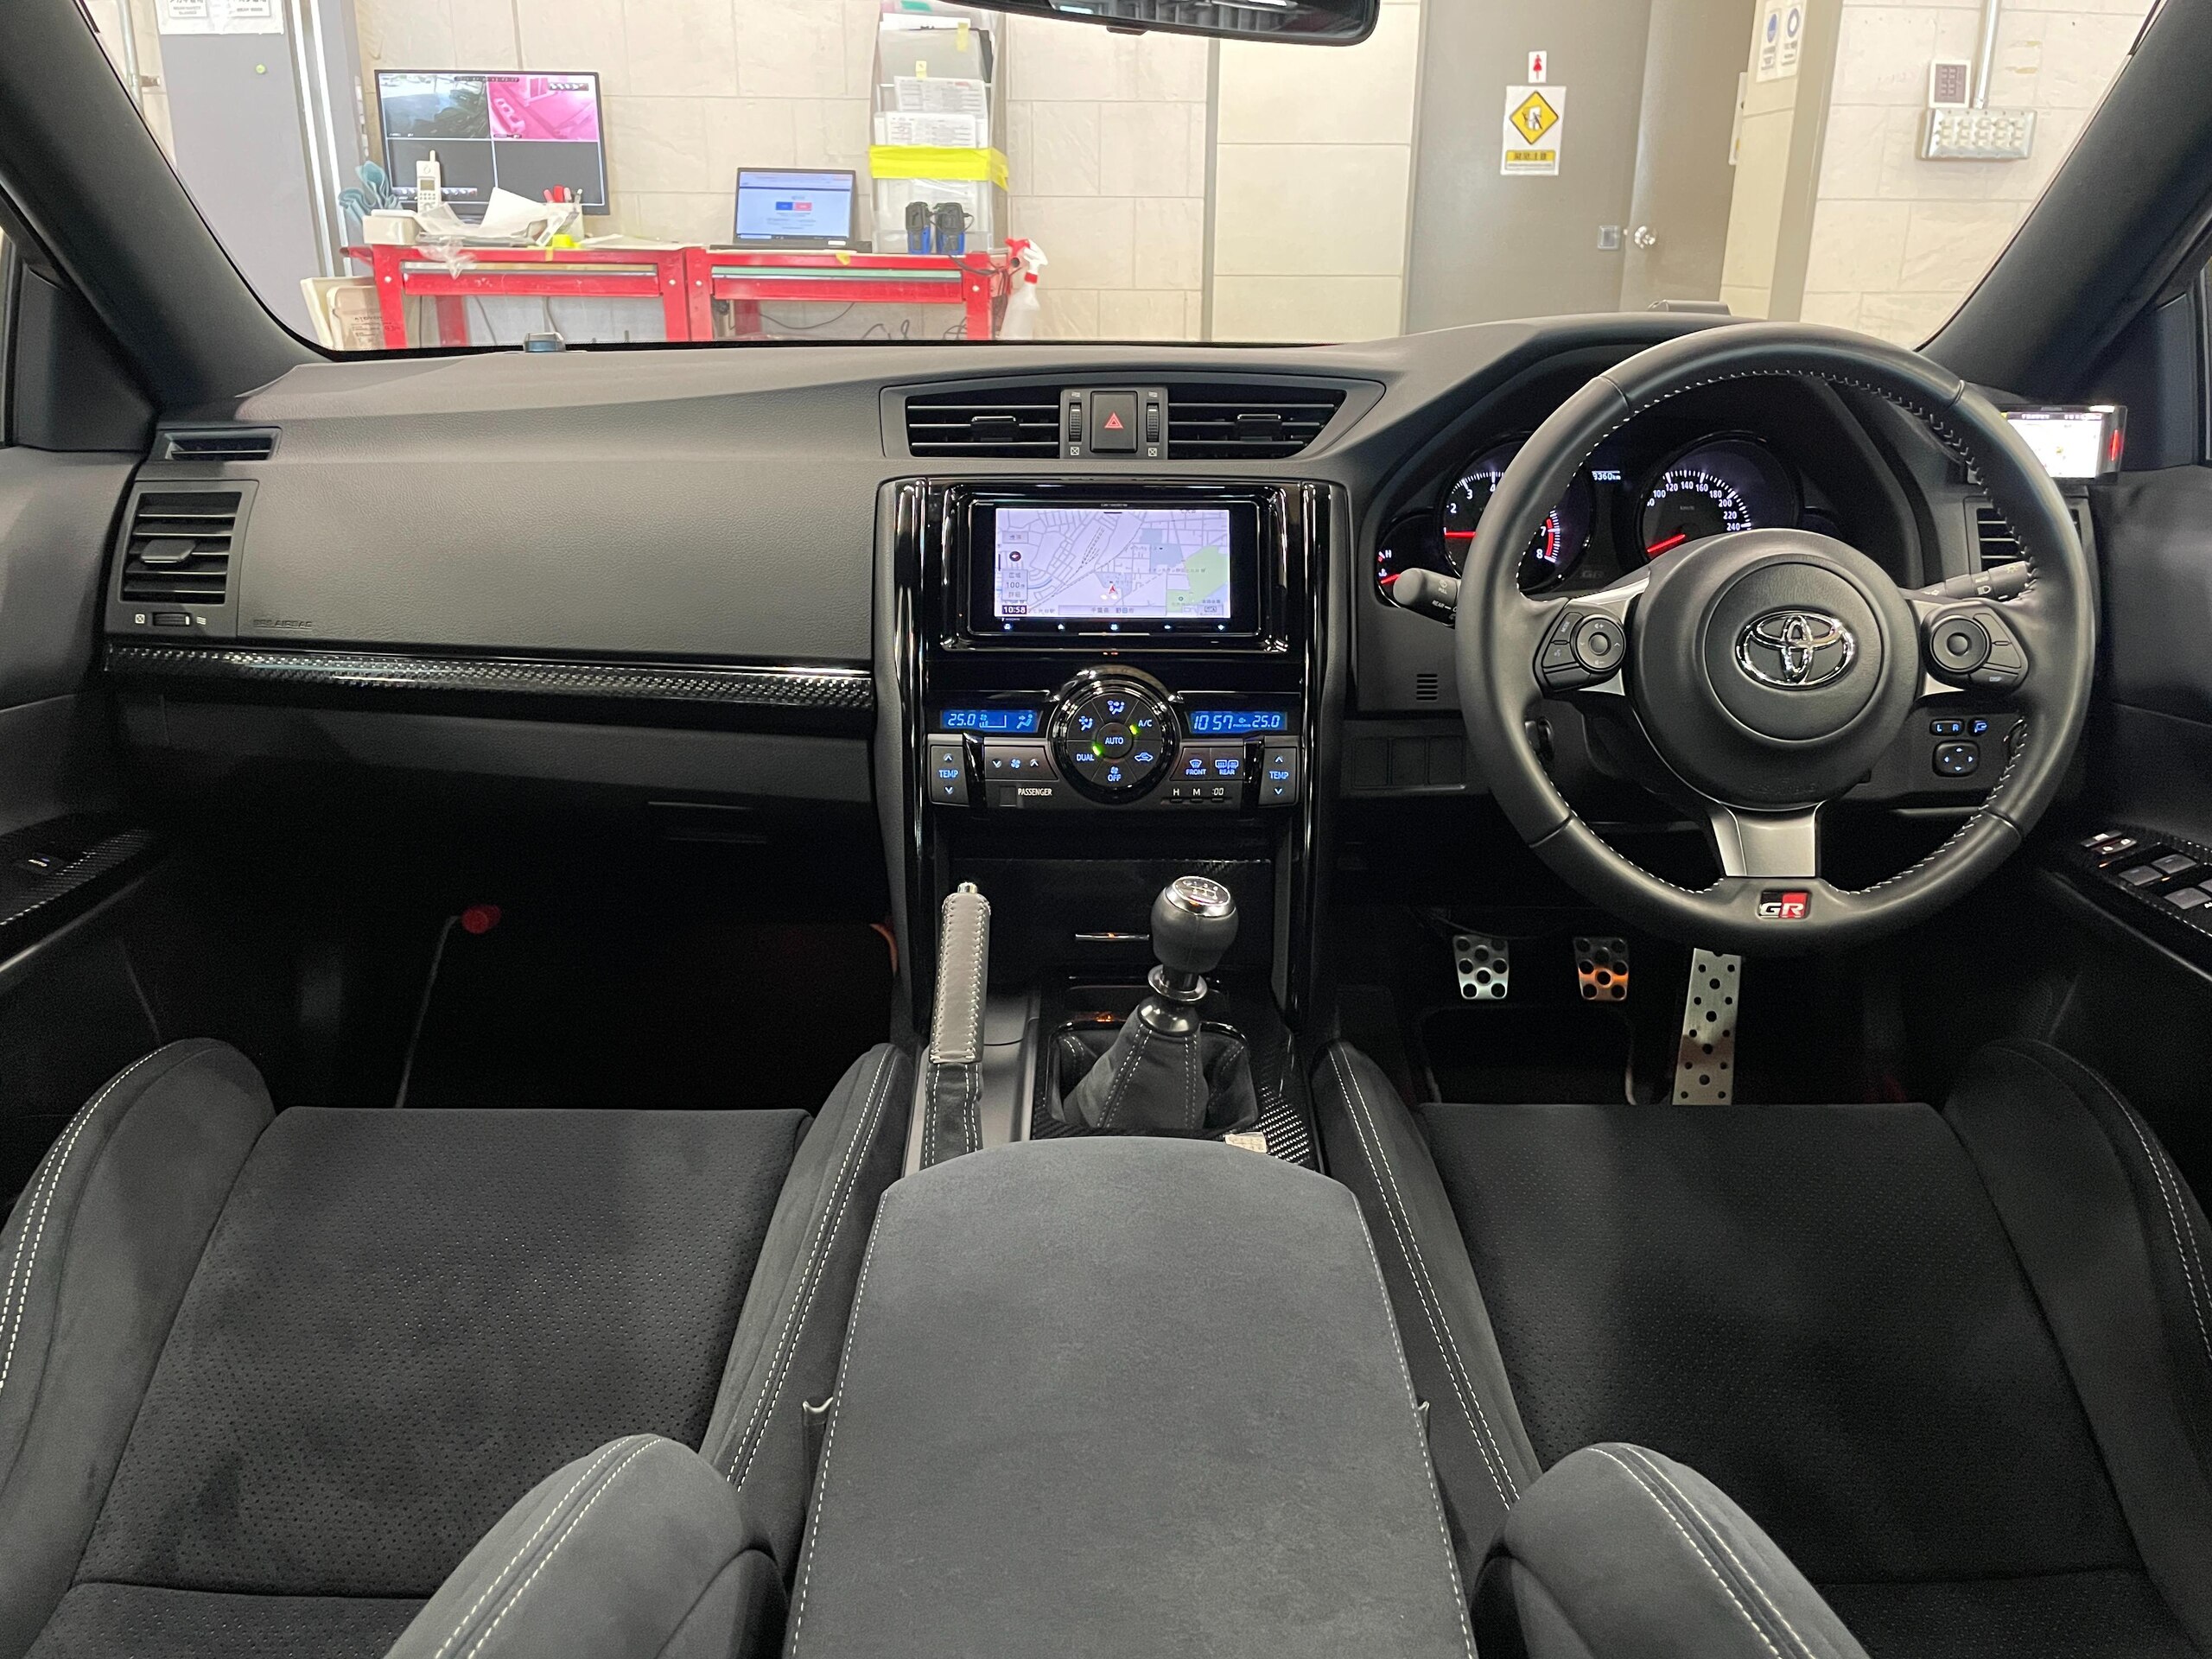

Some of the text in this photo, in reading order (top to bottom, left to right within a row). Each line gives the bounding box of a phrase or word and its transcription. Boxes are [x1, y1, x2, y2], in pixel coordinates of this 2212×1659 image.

[1665, 483, 1678, 492] 120
[1681, 480, 1694, 490] 140
[1695, 483, 1708, 493] 160
[1466, 488, 1473, 499] 3
[1653, 490, 1666, 499] 100
[1709, 490, 1722, 499] 180
[1719, 499, 1732, 508] 200
[1450, 503, 1457, 514] 2
[1723, 512, 1737, 520] 220
[1726, 522, 1740, 531] 240
[1540, 526, 1547, 537] 7
[1384, 550, 1392, 558] H
[1535, 548, 1543, 559] 8
[947, 713, 976, 727] 25.0
[1138, 719, 1153, 728] A/C
[1251, 715, 1281, 728] 25.0
[1936, 722, 1960, 732] L R
[938, 769, 959, 779] TEMP
[1107, 773, 1122, 782] OFF
[1269, 771, 1289, 779] TEMP
[1017, 788, 1052, 797] PASSENGER
[1758, 901, 1805, 918] GR
